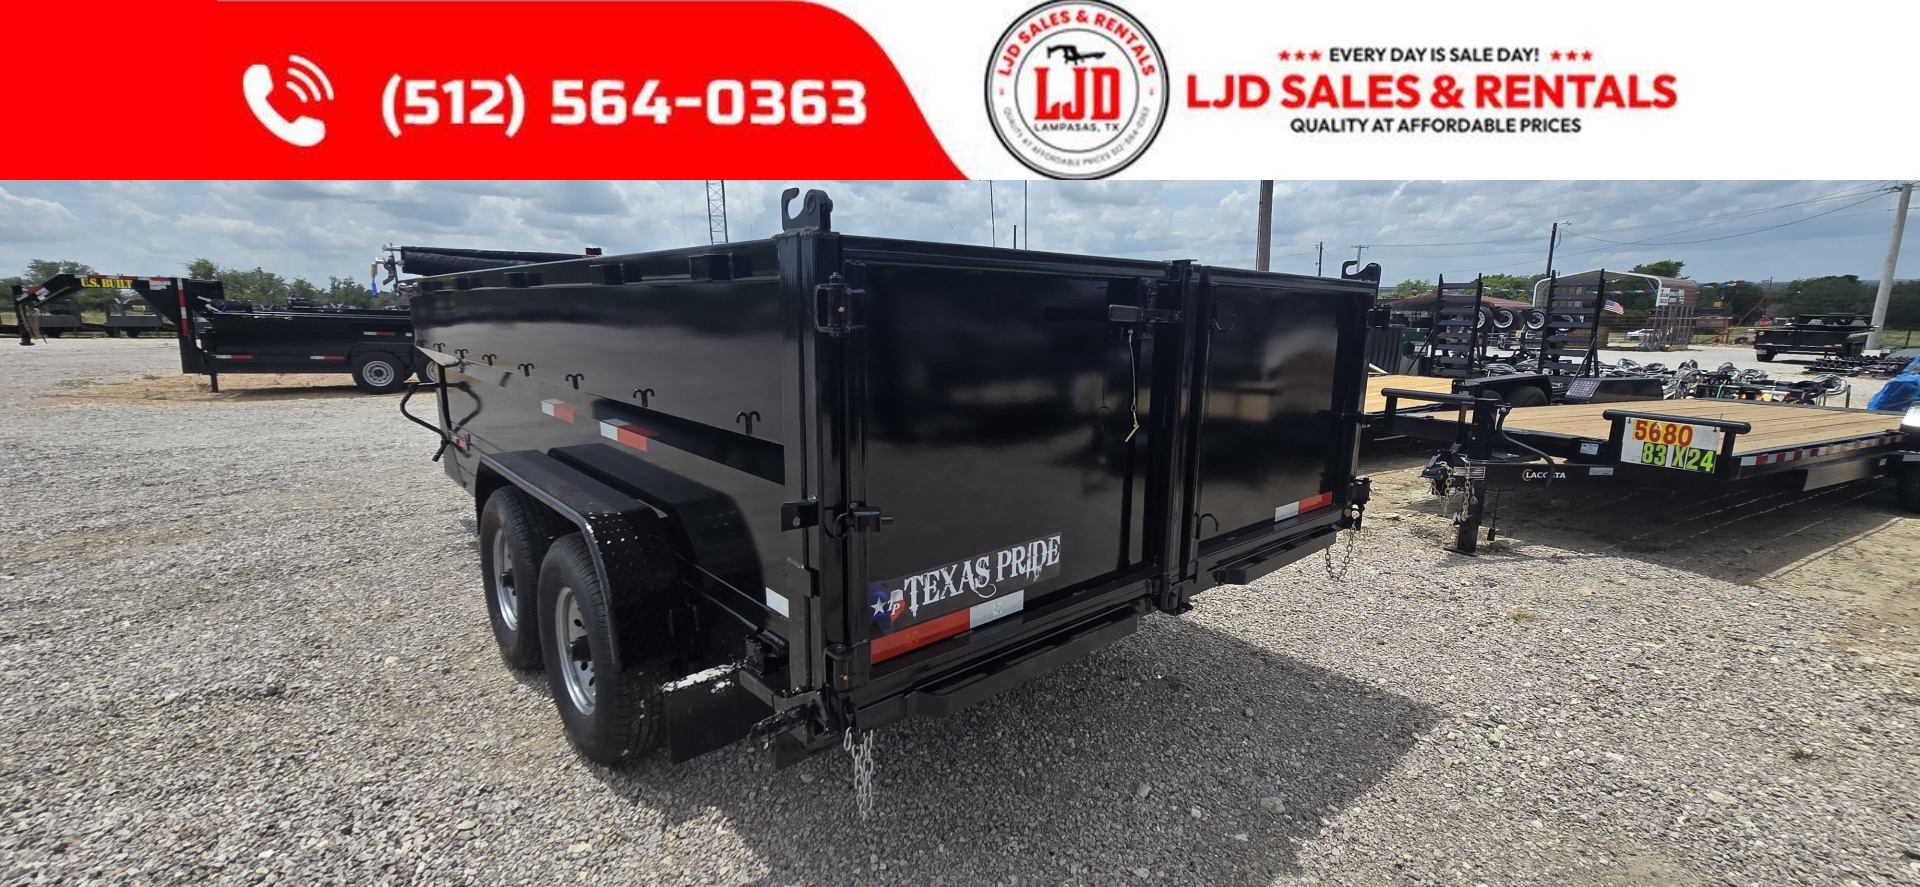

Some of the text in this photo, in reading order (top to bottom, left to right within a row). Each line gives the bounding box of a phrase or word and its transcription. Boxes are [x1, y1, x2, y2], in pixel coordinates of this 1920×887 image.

[80, 278, 133, 289] U.S. BUILT
[1634, 420, 1693, 447] 5680
[1642, 442, 1667, 466] 83
[904, 535, 1061, 617] TEXAS PRIDE
